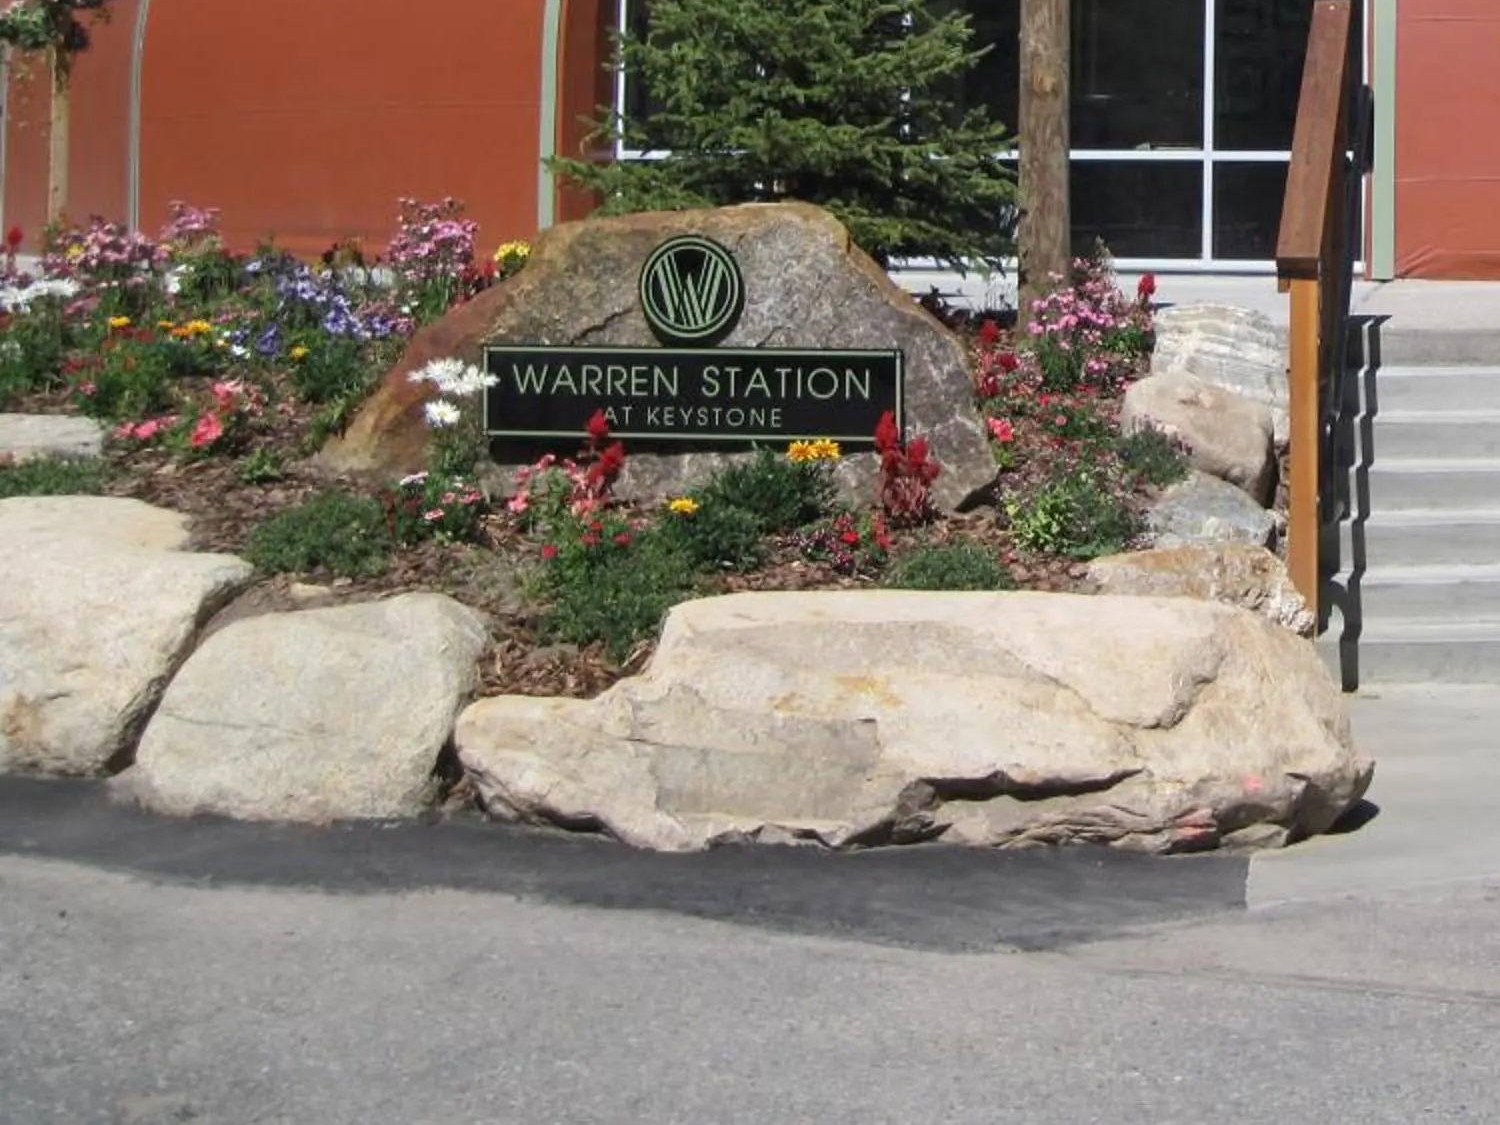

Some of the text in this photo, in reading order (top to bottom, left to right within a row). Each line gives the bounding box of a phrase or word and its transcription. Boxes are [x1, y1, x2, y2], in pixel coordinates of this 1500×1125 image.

[512, 363, 871, 400] WARREN STATION
[602, 406, 782, 428] AT KEYSTONE
